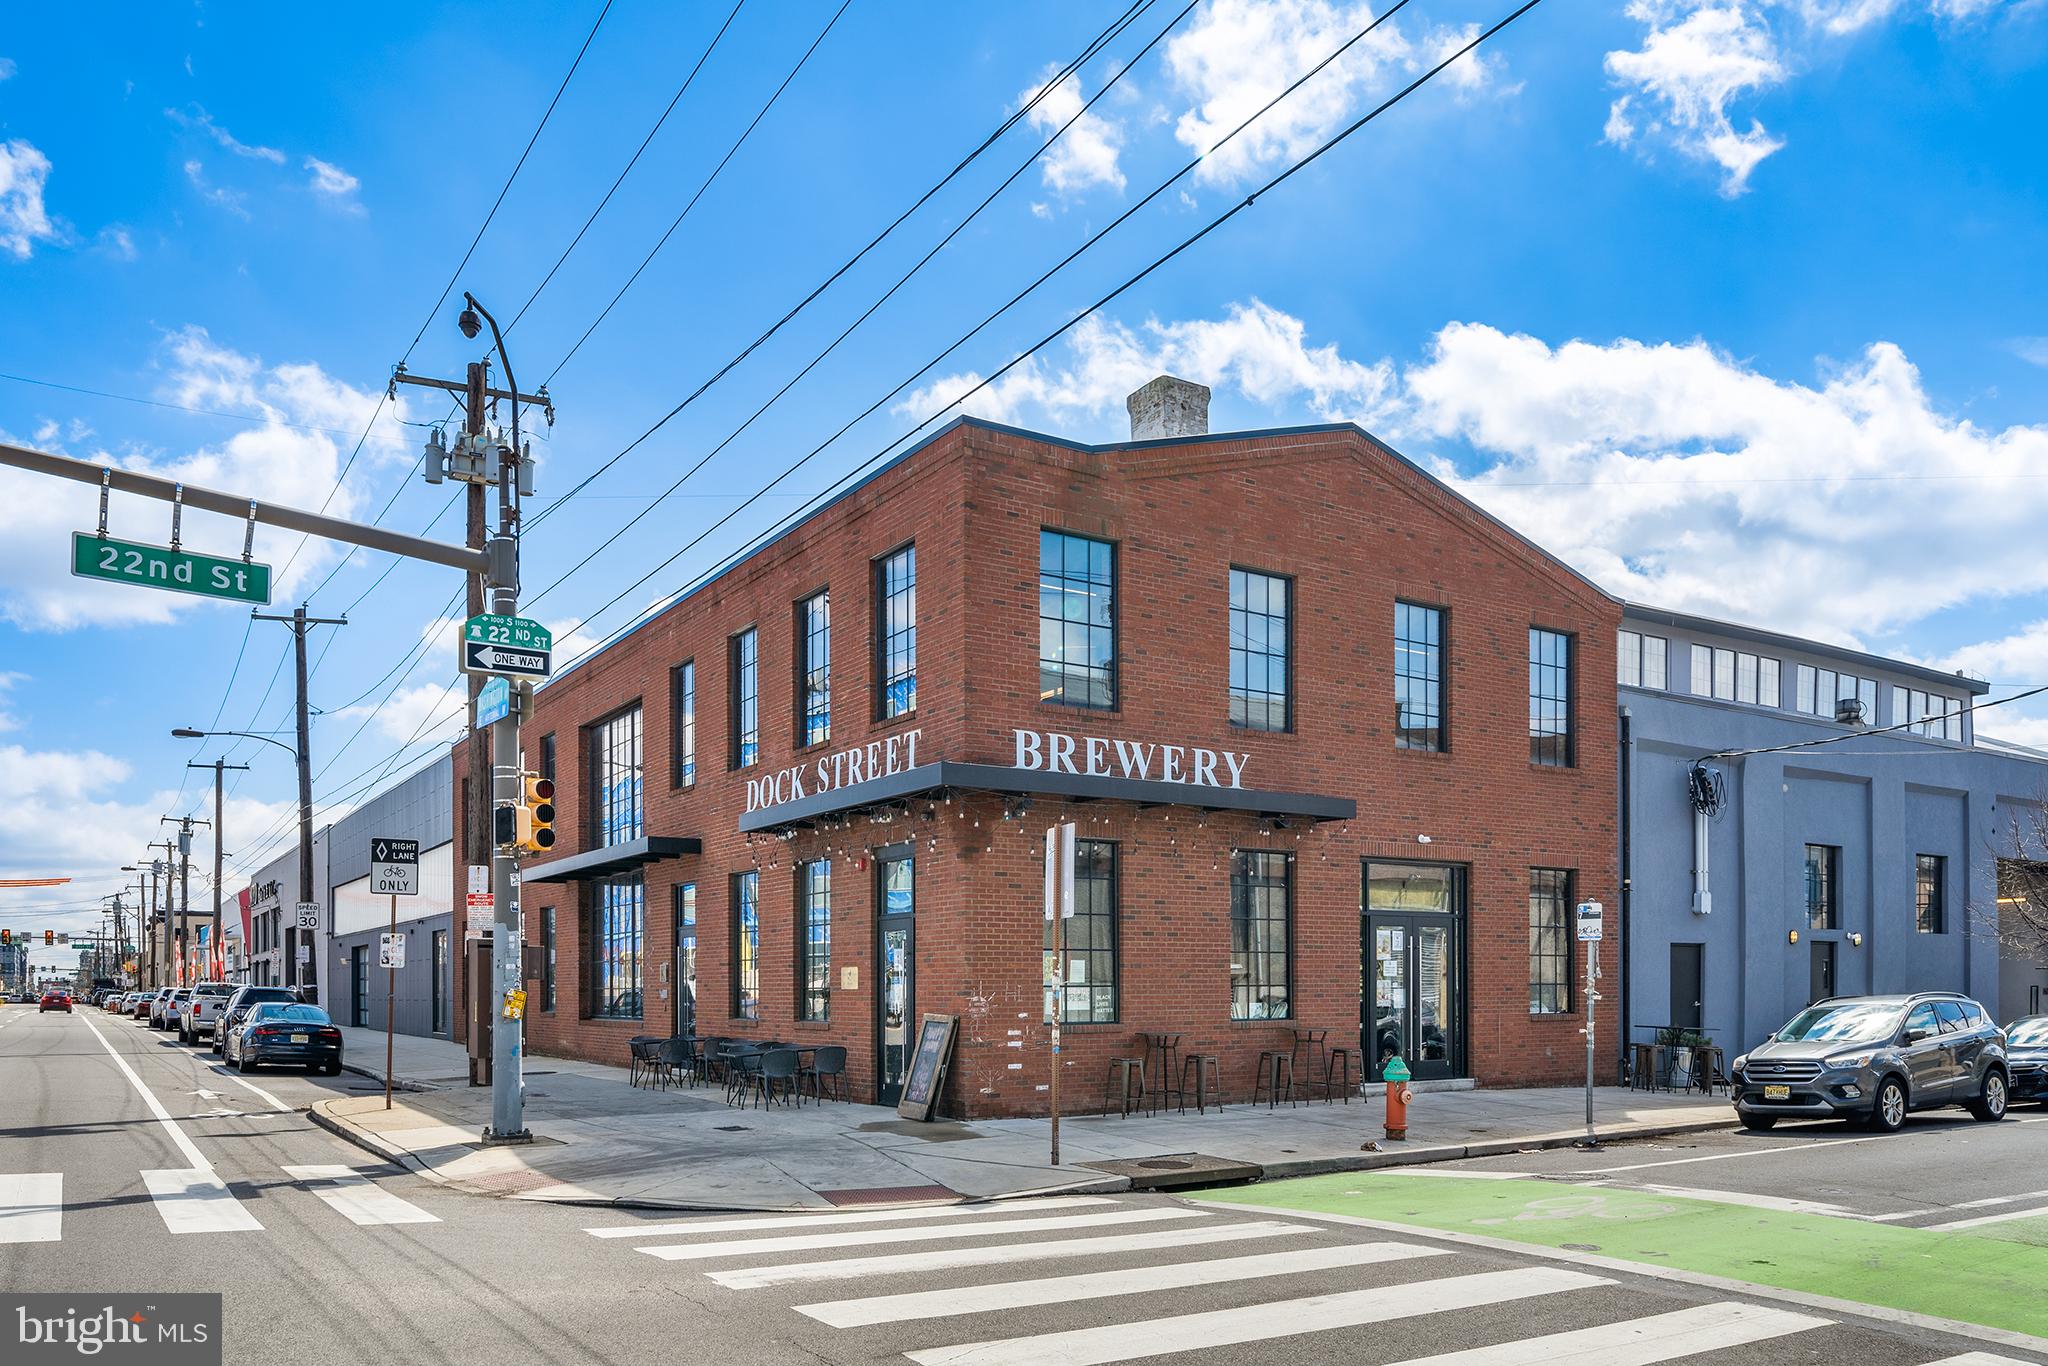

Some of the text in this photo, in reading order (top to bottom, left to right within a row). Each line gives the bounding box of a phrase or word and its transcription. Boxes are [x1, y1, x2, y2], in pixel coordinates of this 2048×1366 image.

[99, 546, 248, 592] 22nd St
[490, 616, 504, 624] 1000
[506, 617, 513, 626] S
[488, 625, 548, 648] 22 ND ST
[494, 653, 541, 668] ONE WAY
[1010, 728, 1252, 790] BREWERY
[745, 729, 922, 814] DOCK STREET
[391, 842, 417, 851] RIGHT
[393, 852, 415, 860] LANE
[379, 879, 409, 891] ONLY
[299, 916, 317, 927] 30
